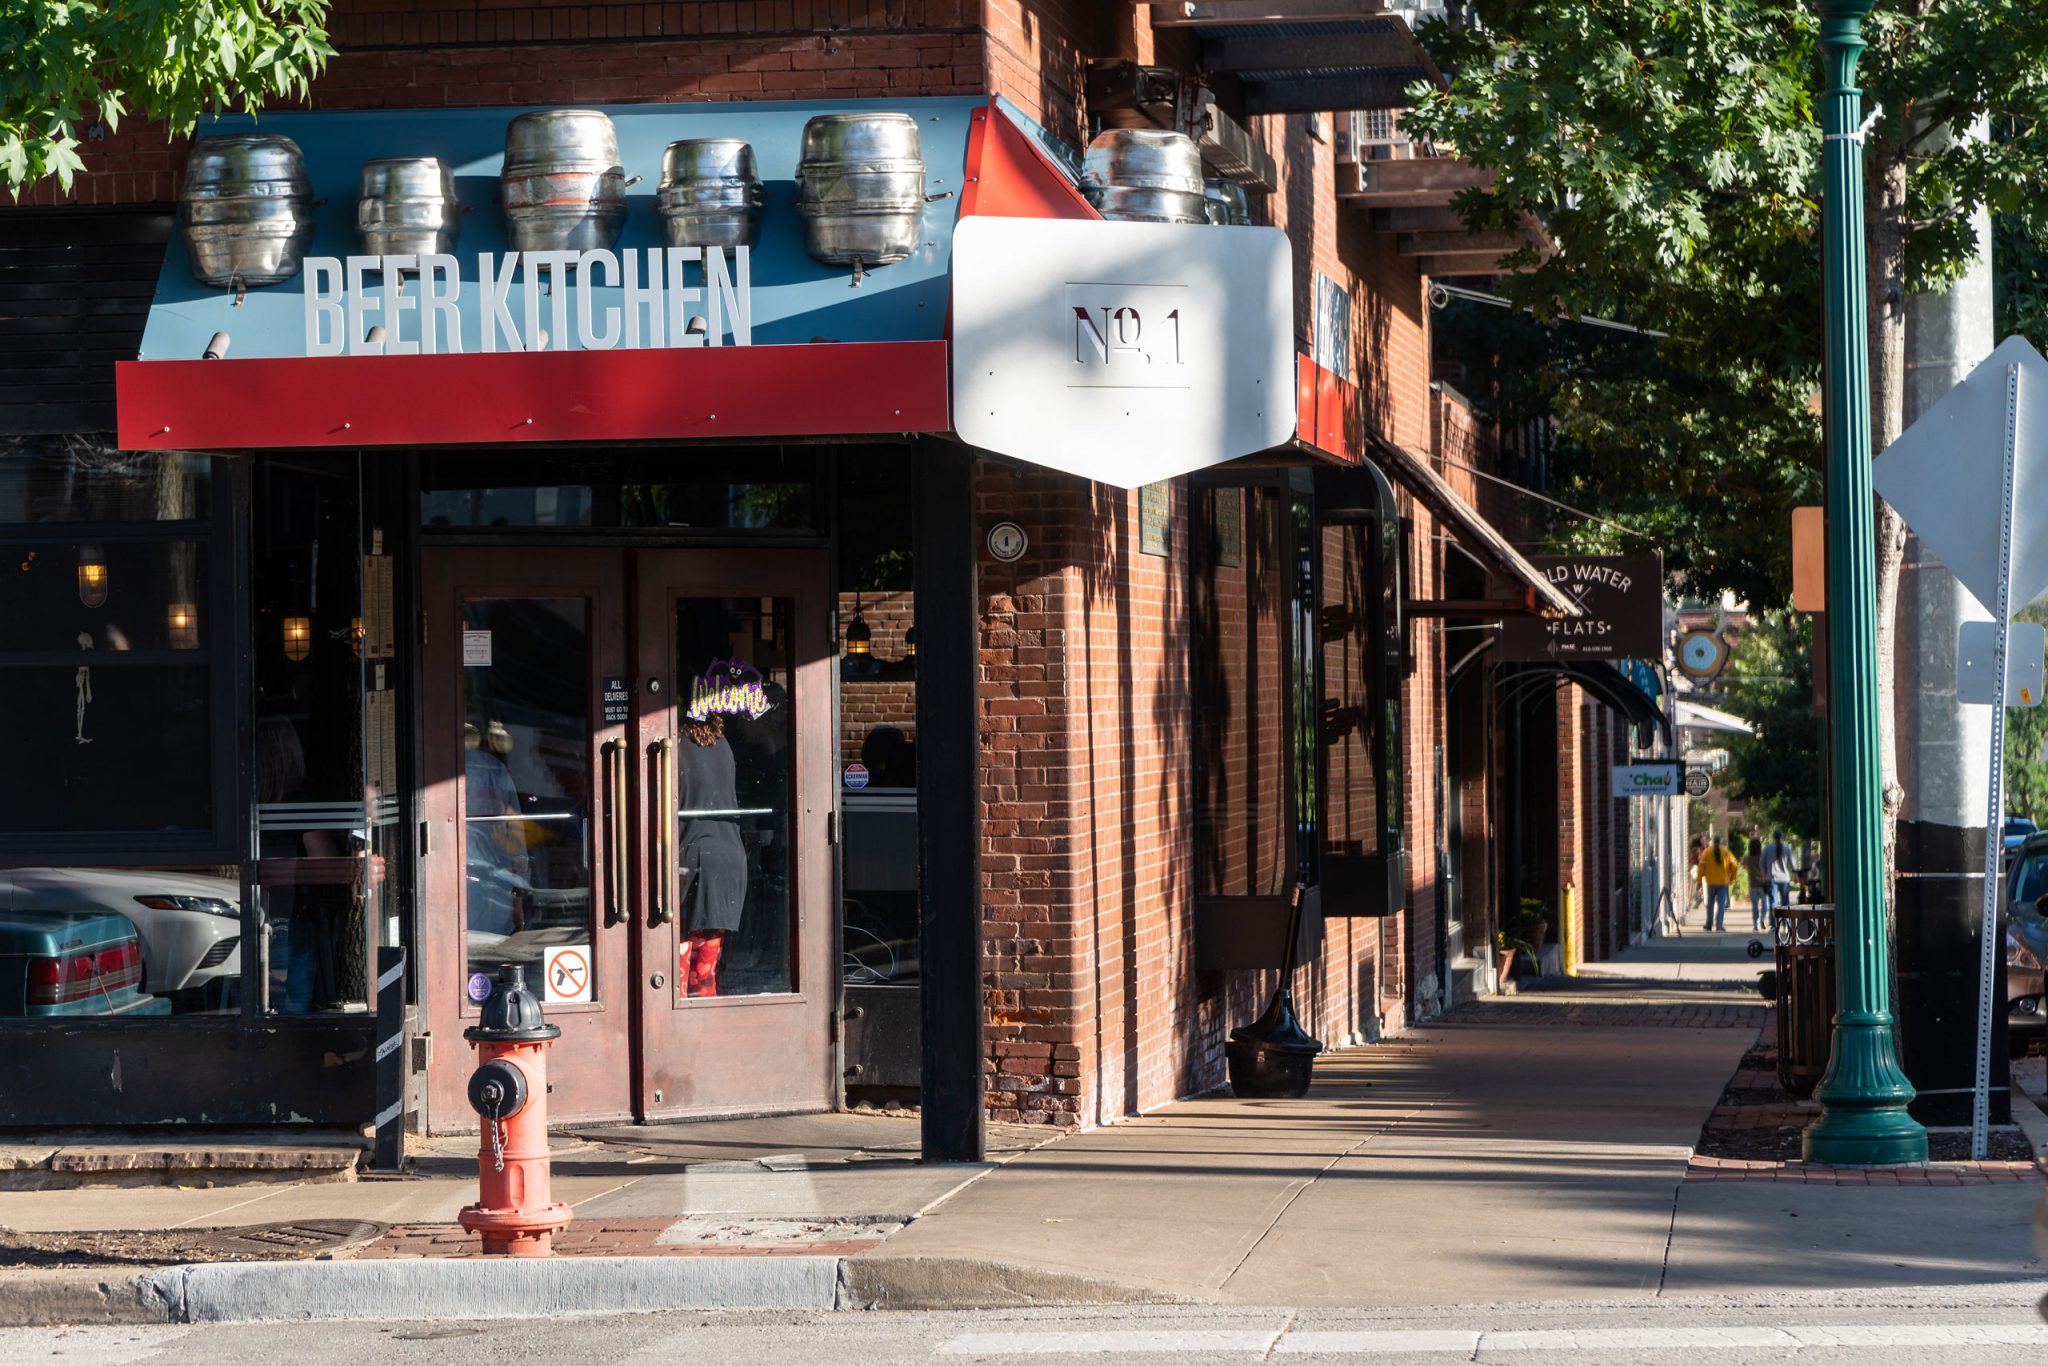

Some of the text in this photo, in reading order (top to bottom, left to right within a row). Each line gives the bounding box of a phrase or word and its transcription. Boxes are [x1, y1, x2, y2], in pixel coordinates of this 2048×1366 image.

[303, 245, 752, 356] BEER KITCHEN
[1166, 309, 1184, 365] 1
[1573, 564, 1632, 594] WATER
[1552, 621, 1606, 636] FLATS
[611, 680, 622, 690] ALL
[692, 674, 767, 718] Welcome
